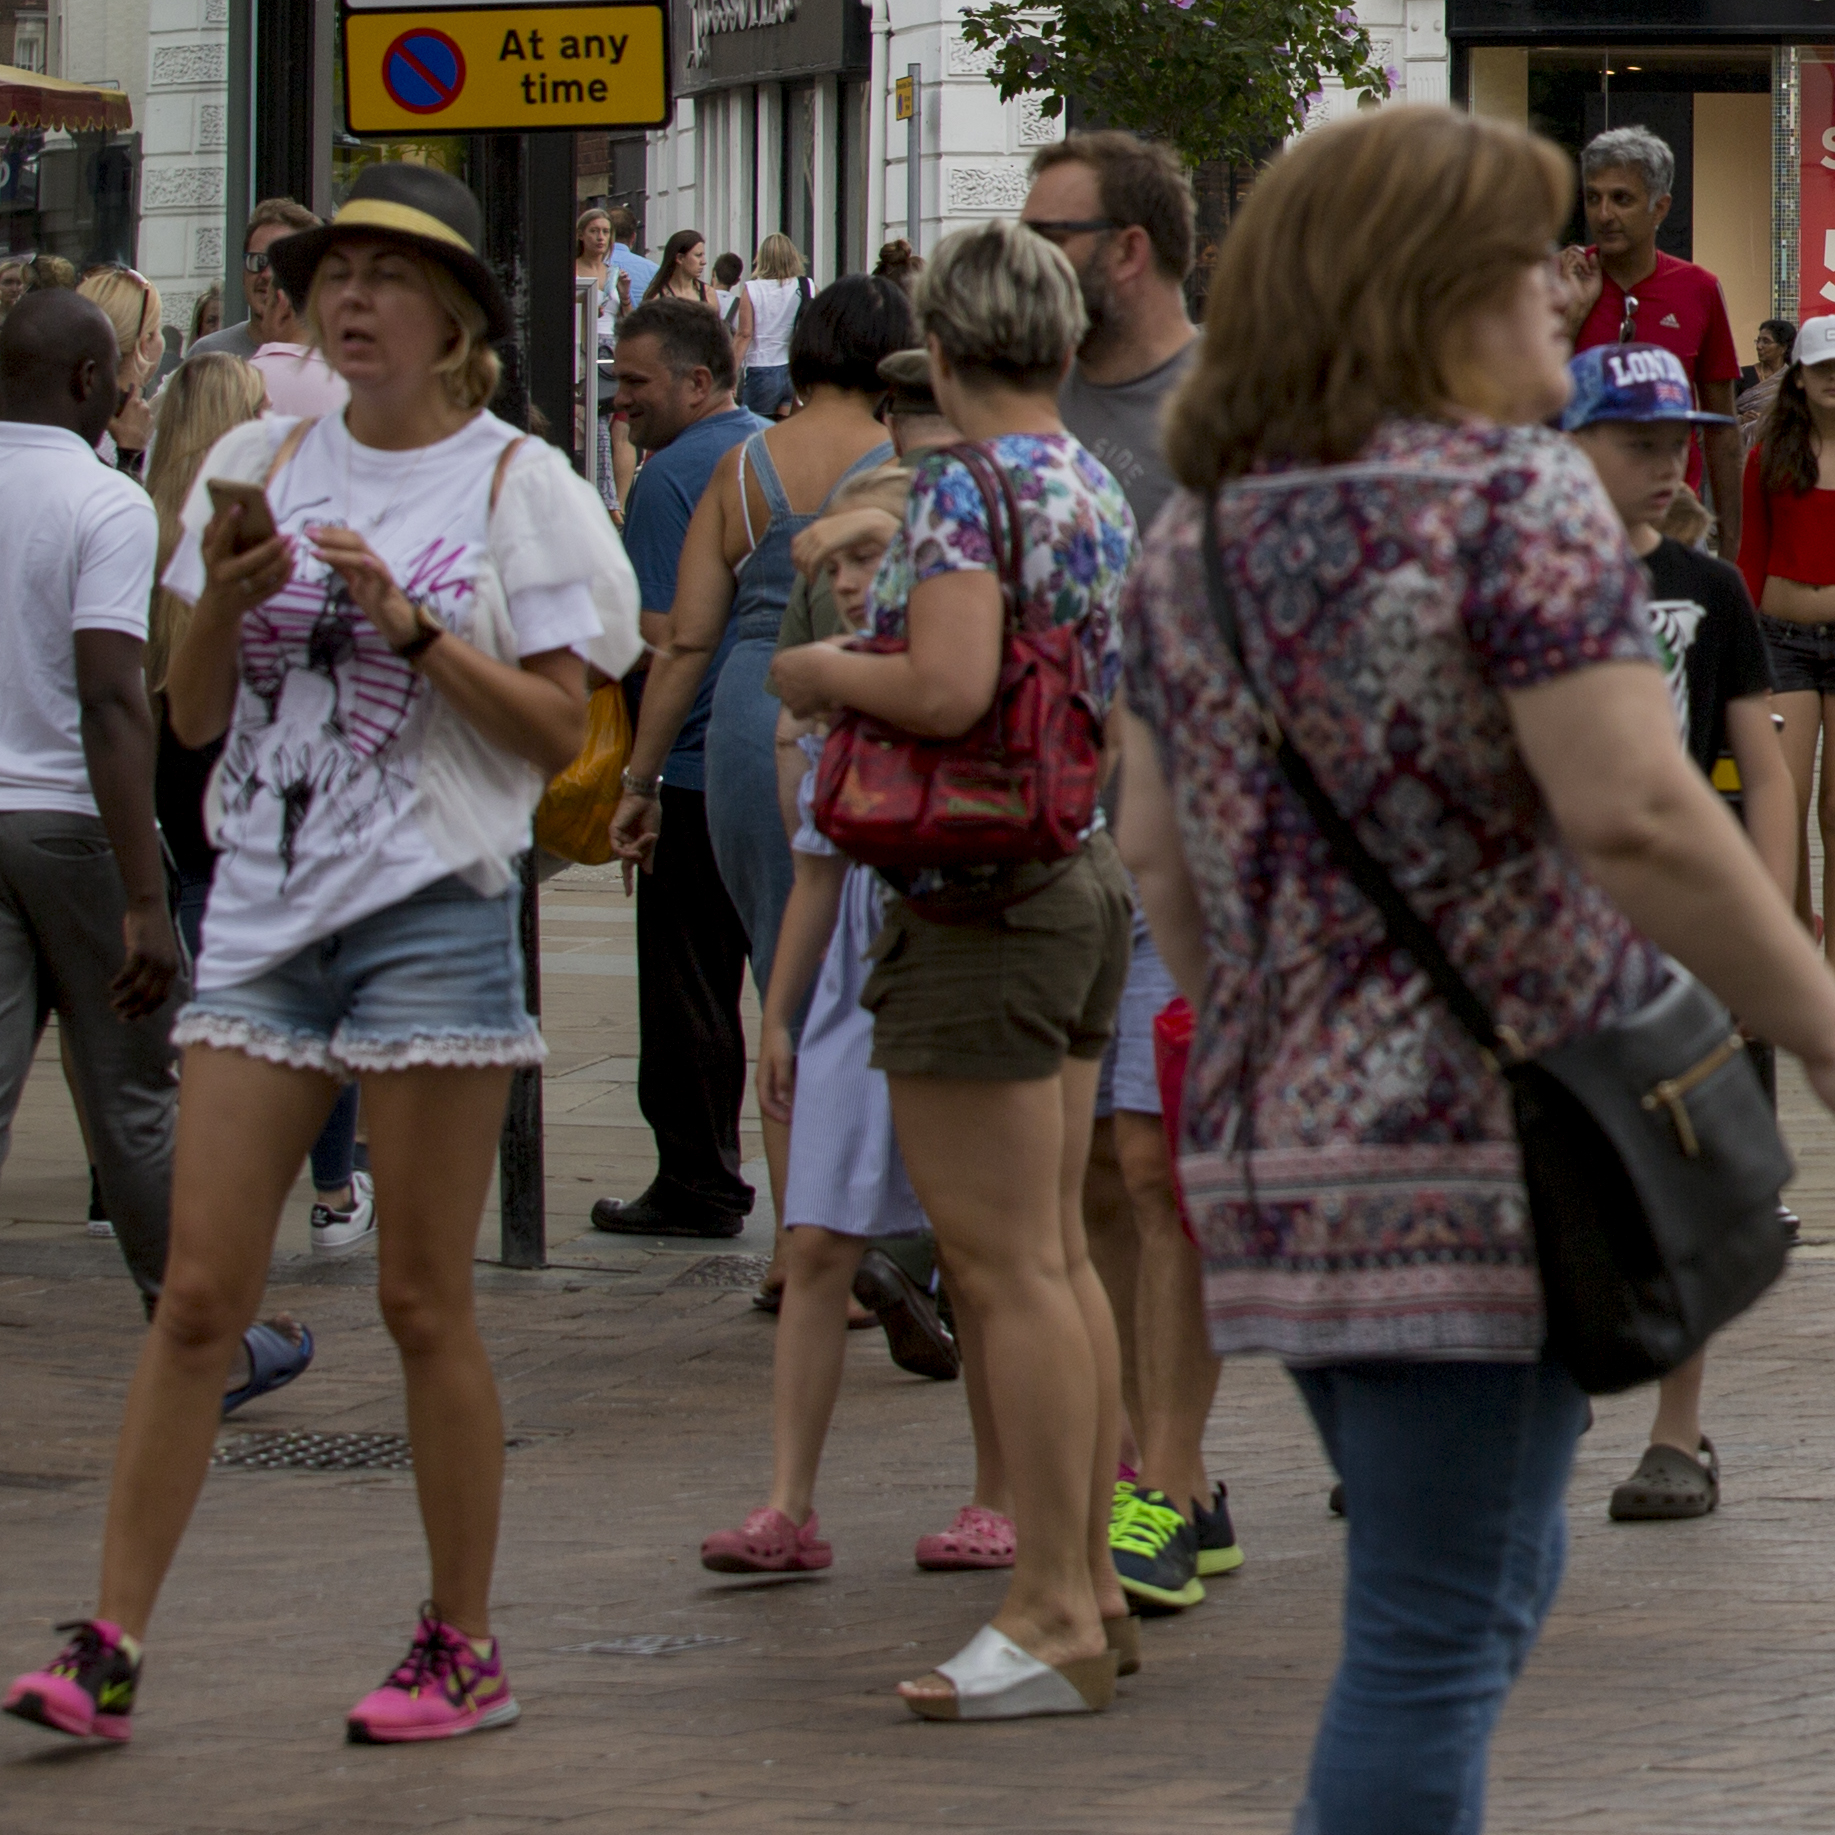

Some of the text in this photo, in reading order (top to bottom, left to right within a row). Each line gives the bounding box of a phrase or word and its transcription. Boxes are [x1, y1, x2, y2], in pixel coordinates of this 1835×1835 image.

[499, 28, 629, 65] At any
[521, 72, 608, 105] time
